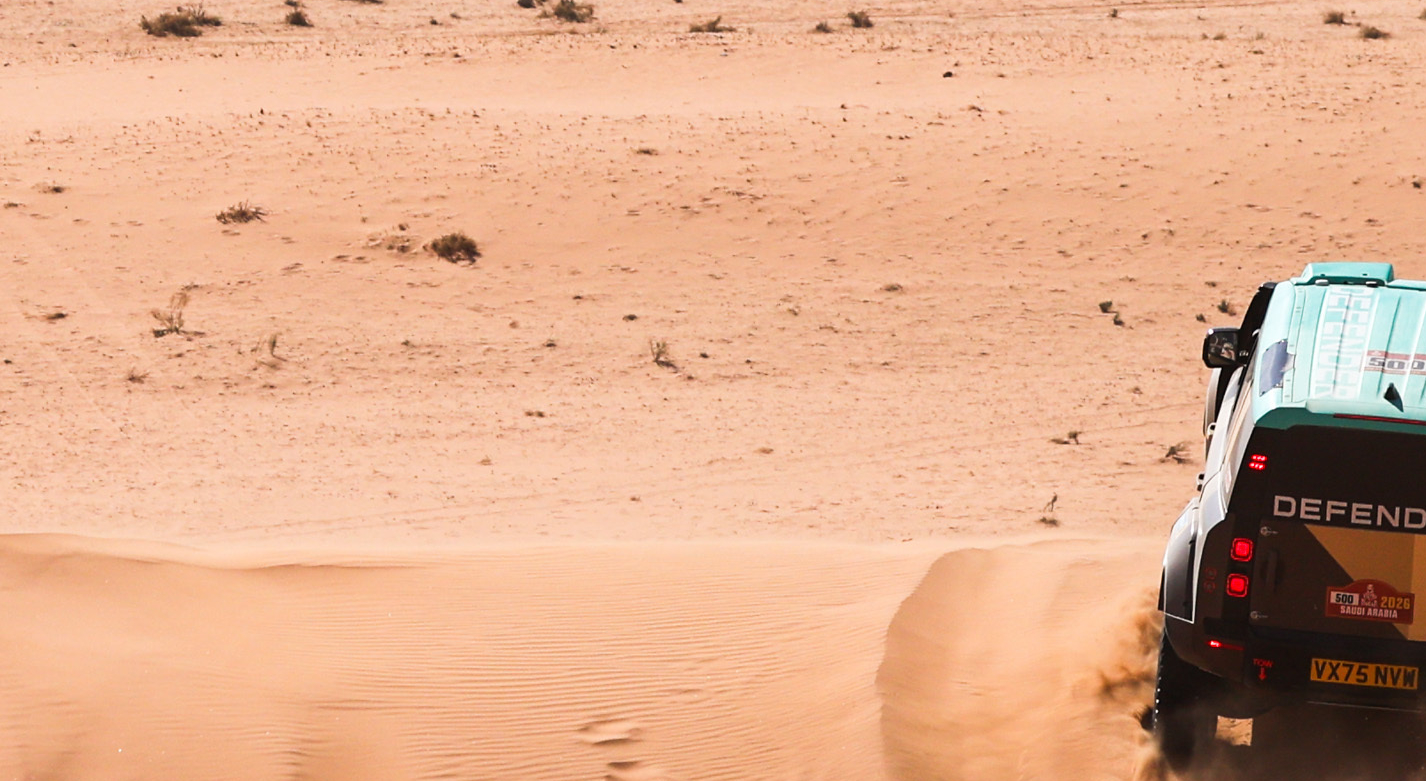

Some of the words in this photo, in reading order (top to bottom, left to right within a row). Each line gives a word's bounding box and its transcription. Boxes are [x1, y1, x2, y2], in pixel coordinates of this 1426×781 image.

[1315, 287, 1373, 398] DEFENDER
[1368, 357, 1426, 370] 500
[1335, 593, 1354, 604] 500
[1380, 596, 1411, 610] 2026
[1340, 605, 1365, 615] SAUDI
[1366, 607, 1398, 618] ARABIA
[1253, 658, 1273, 668] TOW
[1315, 660, 1369, 684] VX75
[1374, 666, 1417, 688] NVW
